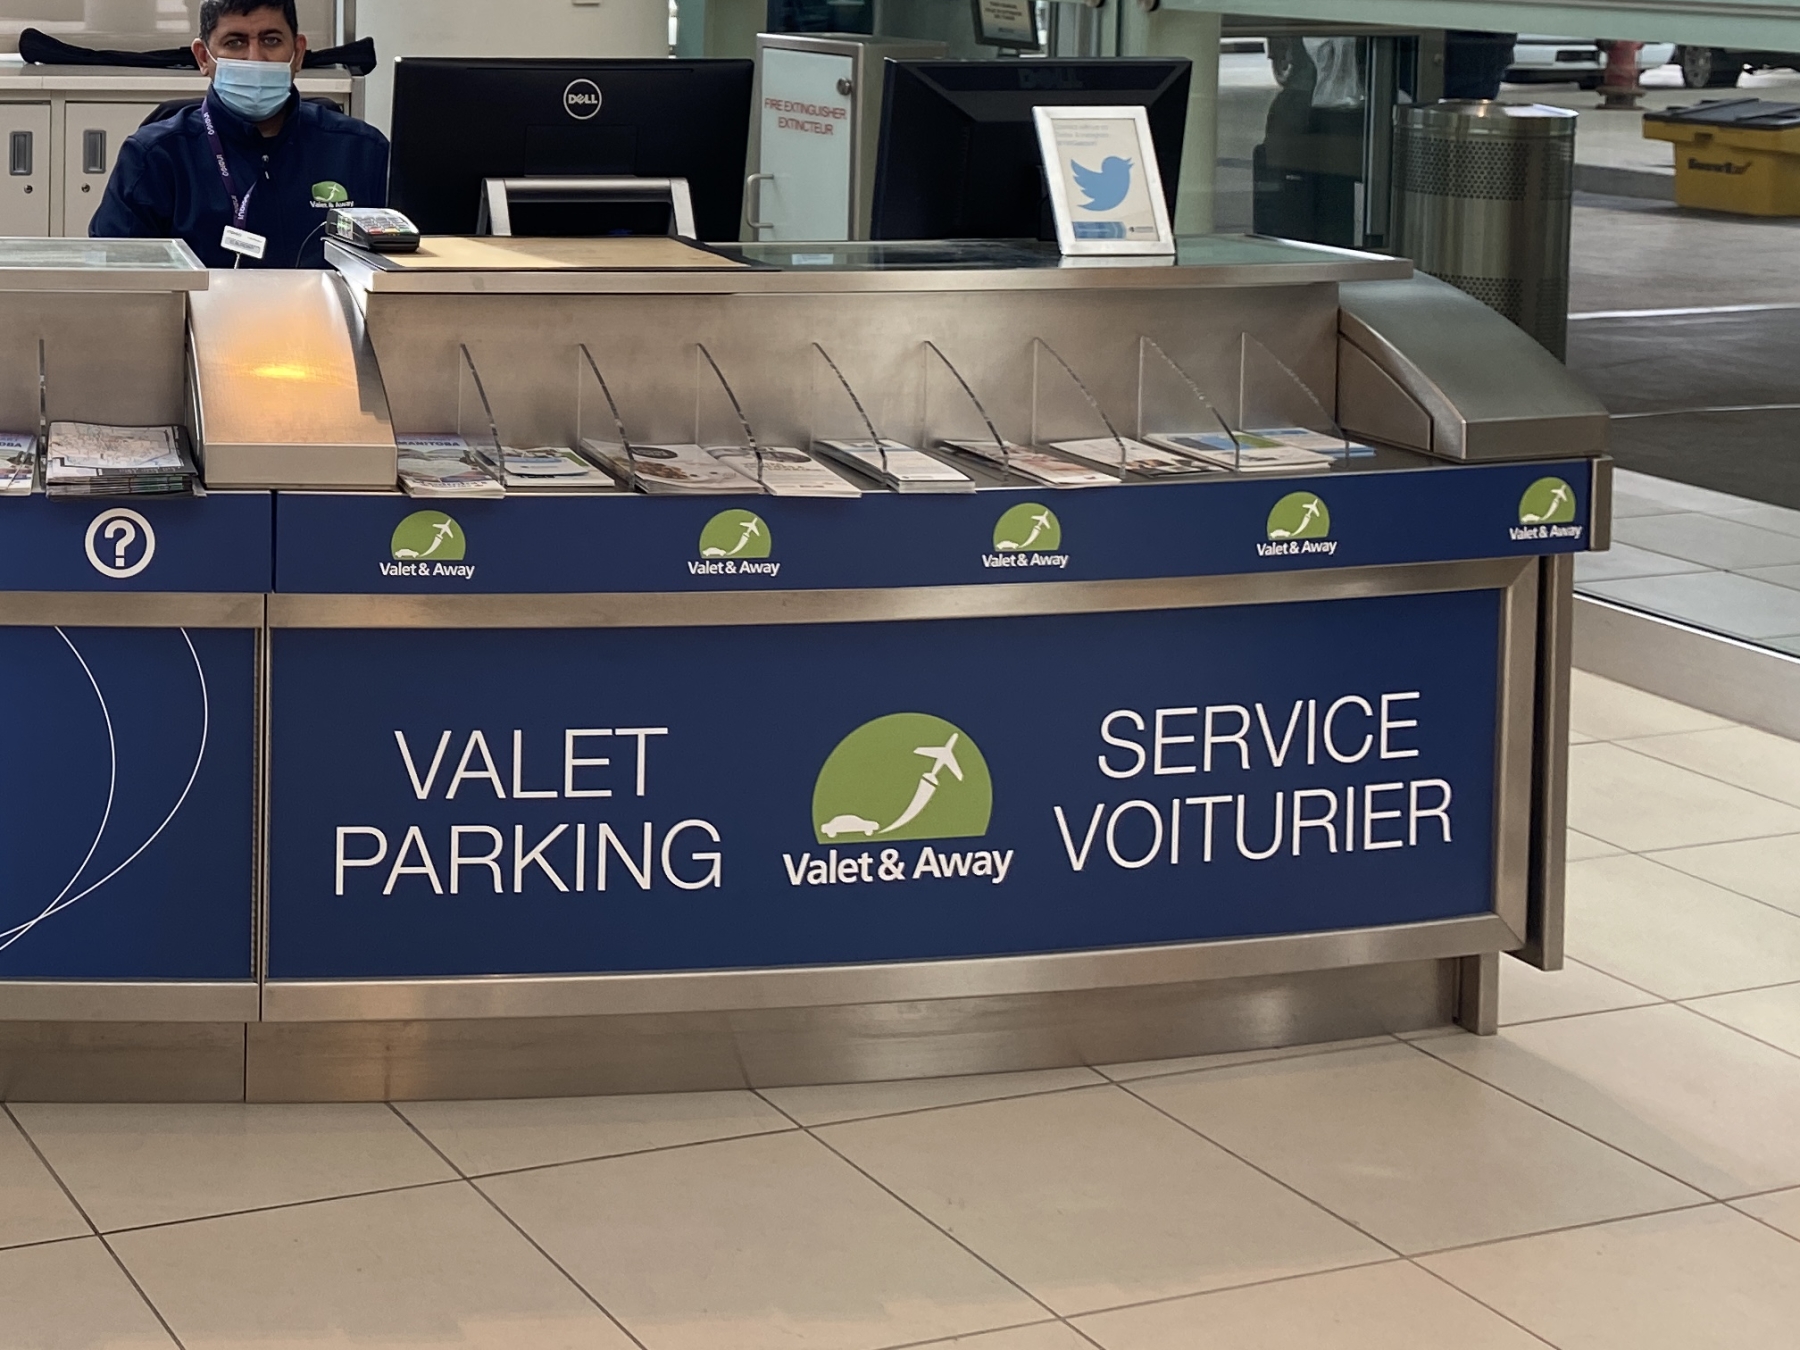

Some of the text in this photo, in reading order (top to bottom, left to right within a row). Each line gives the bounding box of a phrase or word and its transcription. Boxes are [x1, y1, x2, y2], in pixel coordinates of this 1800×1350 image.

[568, 93, 598, 105] DELL
[764, 97, 847, 120] FIRE EXTINGUISHER
[778, 116, 834, 136] EXTINCTEUR
[1509, 524, 1583, 540] Valet & Away
[1256, 540, 1337, 556] Valet & Away
[379, 561, 476, 580] Valet & Away
[687, 560, 781, 577] Valet & Away
[981, 552, 1069, 569] Valet & Away
[1097, 690, 1422, 781] SERVICE
[393, 726, 670, 801] VALET
[1052, 778, 1454, 874] VOITURIER
[333, 818, 724, 897] PARKING
[782, 846, 1015, 886] Valet & Away
